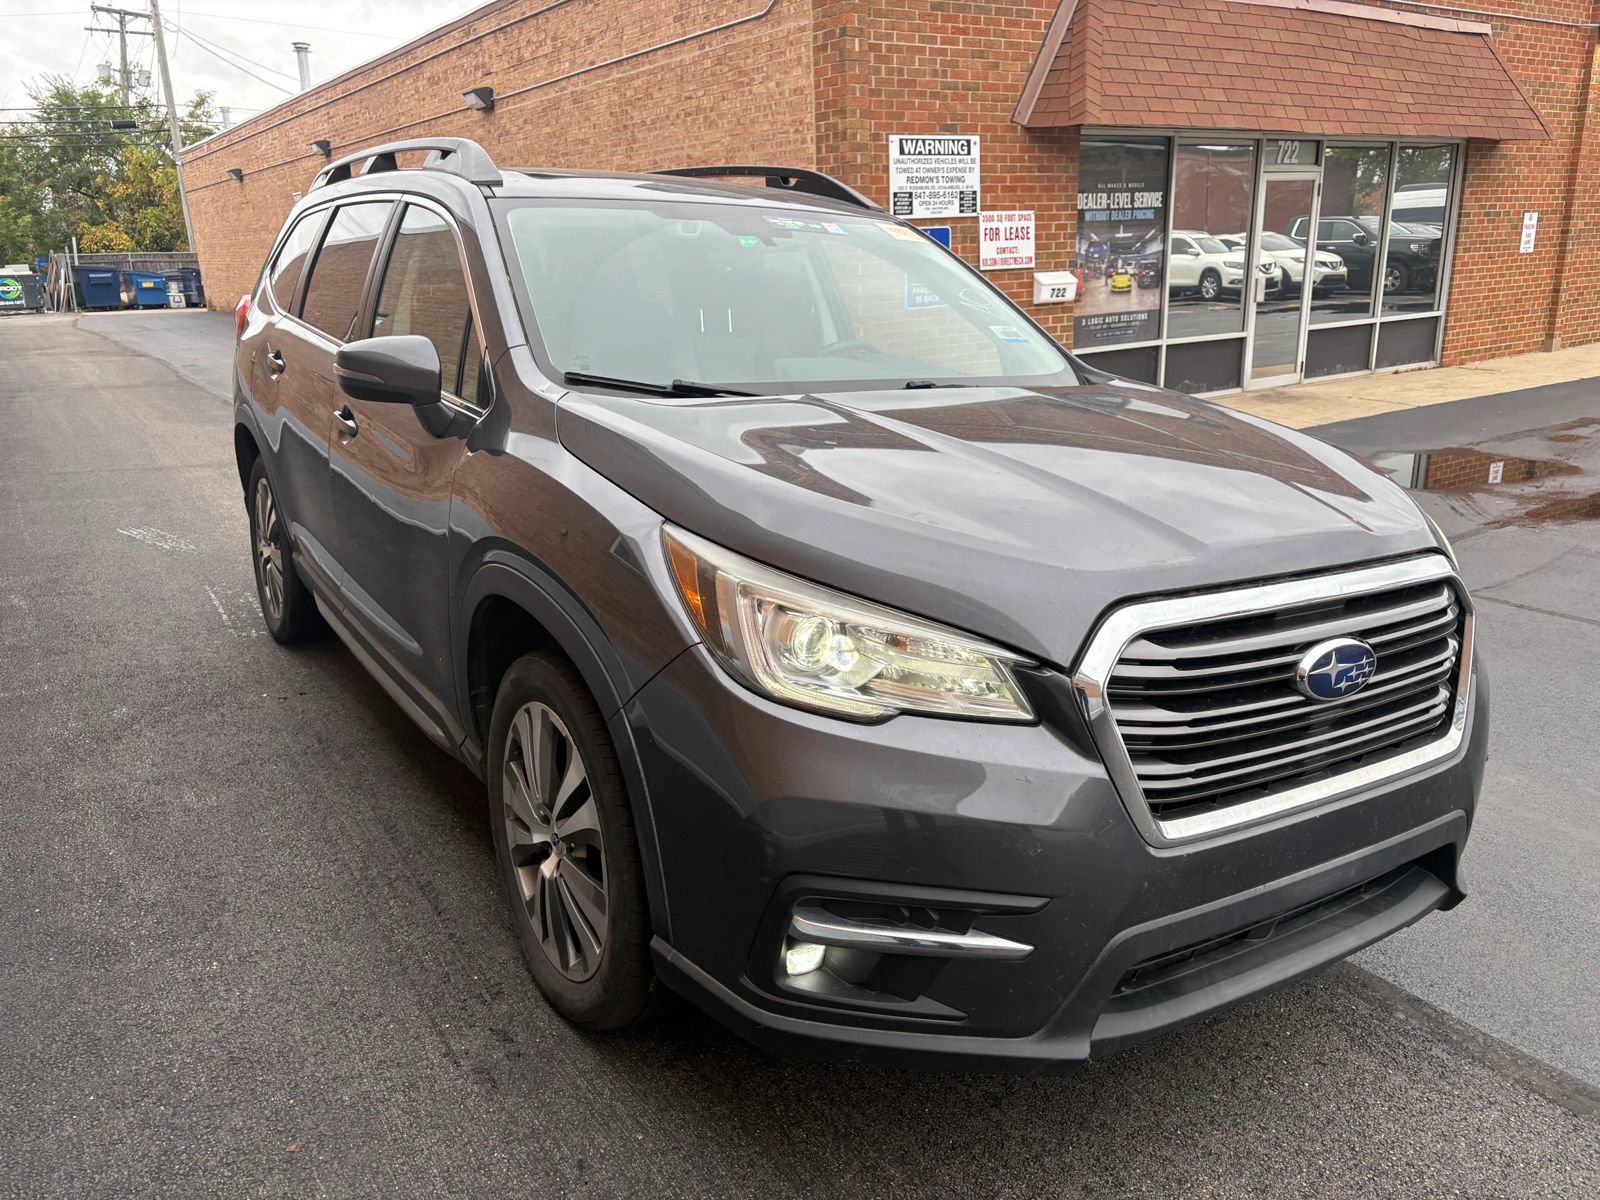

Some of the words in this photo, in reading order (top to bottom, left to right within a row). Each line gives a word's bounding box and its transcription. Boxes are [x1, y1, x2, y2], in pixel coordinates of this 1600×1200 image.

[901, 140, 968, 155] WARNING
[1277, 141, 1300, 164] 722
[893, 157, 933, 165] UNAUTHORIZED
[934, 157, 957, 165] VEHICLES
[958, 157, 969, 165] WILL
[970, 157, 977, 165] BE
[906, 175, 940, 184] REDMON'S
[941, 175, 966, 184] TOWING
[913, 191, 959, 199] 847-895-6162
[1077, 192, 1132, 209] DEALER-LEVEL
[1133, 191, 1163, 208] SERVICE
[1004, 213, 1017, 222] FOOT
[1017, 213, 1032, 222] SPACE
[1111, 209, 1132, 221] DEALER
[983, 227, 1001, 242] FOR
[1004, 226, 1031, 241] LEASE
[996, 246, 1020, 255] CONTACT:
[1050, 287, 1067, 299] 722
[1087, 316, 1104, 325] LOGIC
[1105, 314, 1119, 323] AUTO
[1120, 313, 1148, 322] SOLUTIONS
